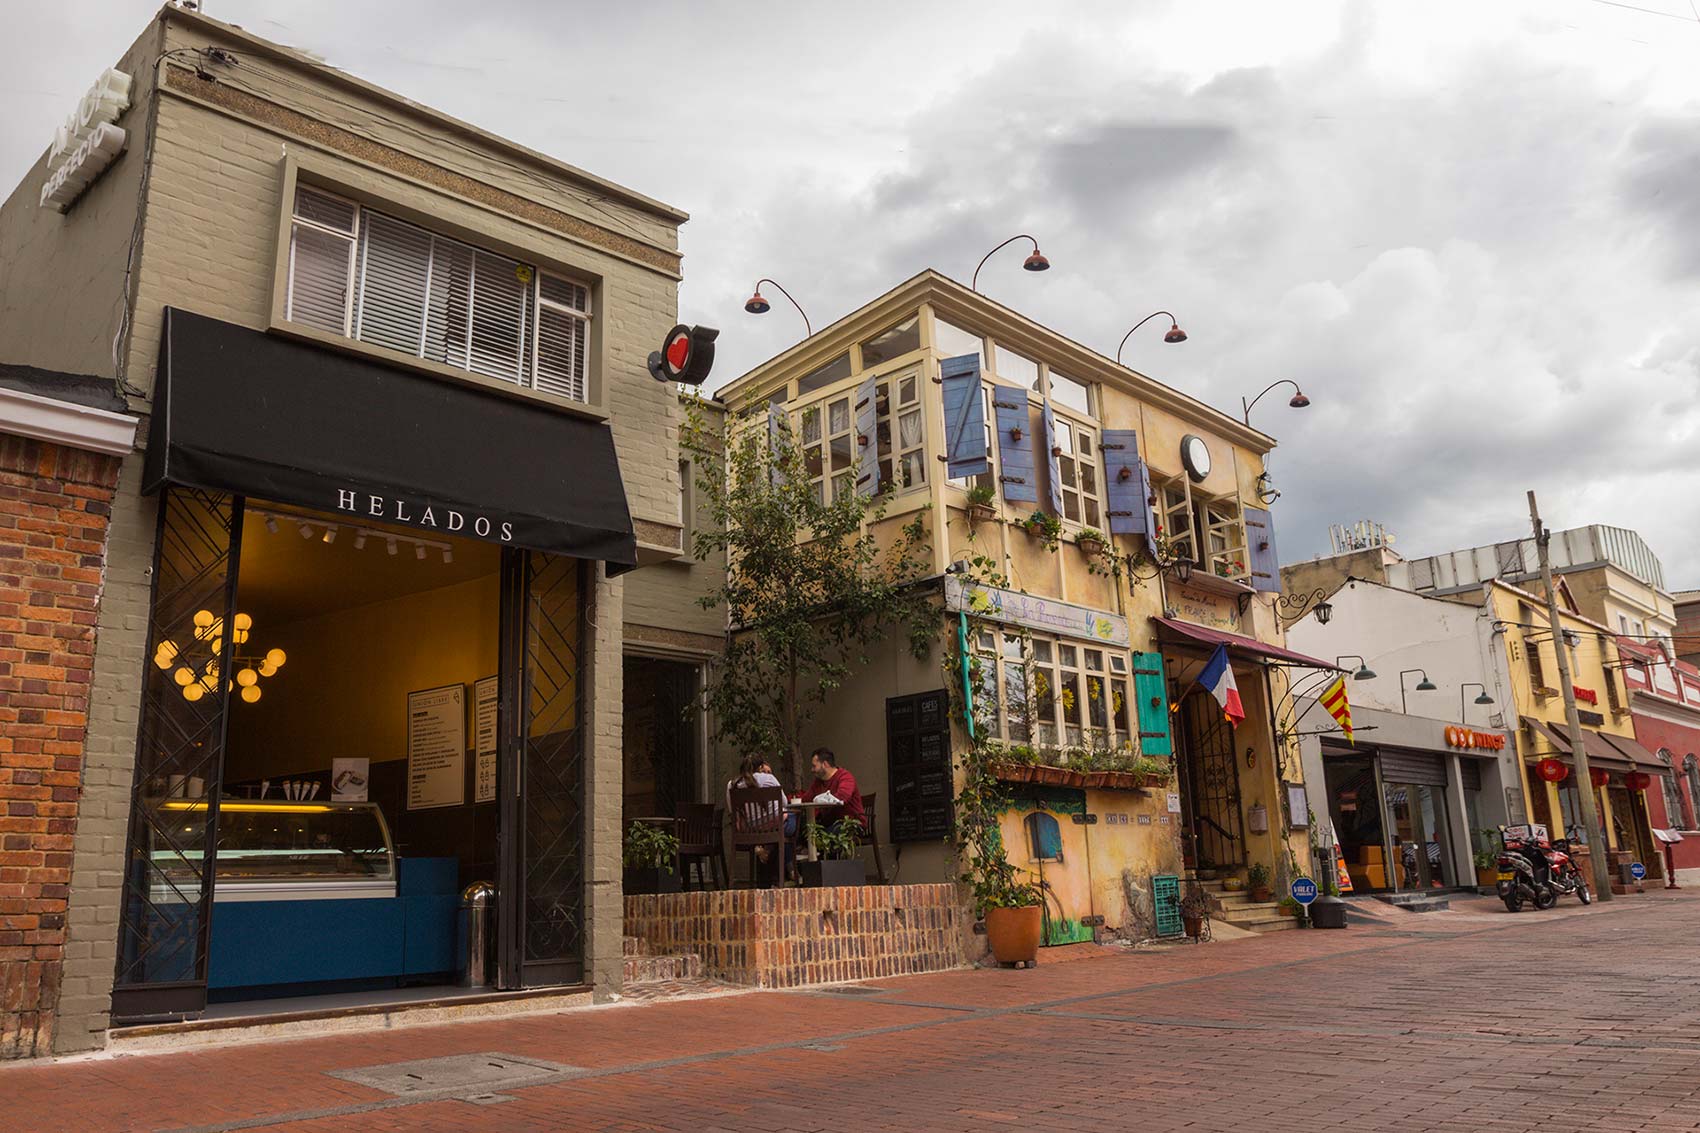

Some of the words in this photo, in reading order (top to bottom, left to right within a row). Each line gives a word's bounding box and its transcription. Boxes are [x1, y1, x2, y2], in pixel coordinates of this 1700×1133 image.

[47, 67, 120, 169] AMOR
[39, 121, 112, 208] PERFECTO
[337, 488, 513, 542] HELADOS
